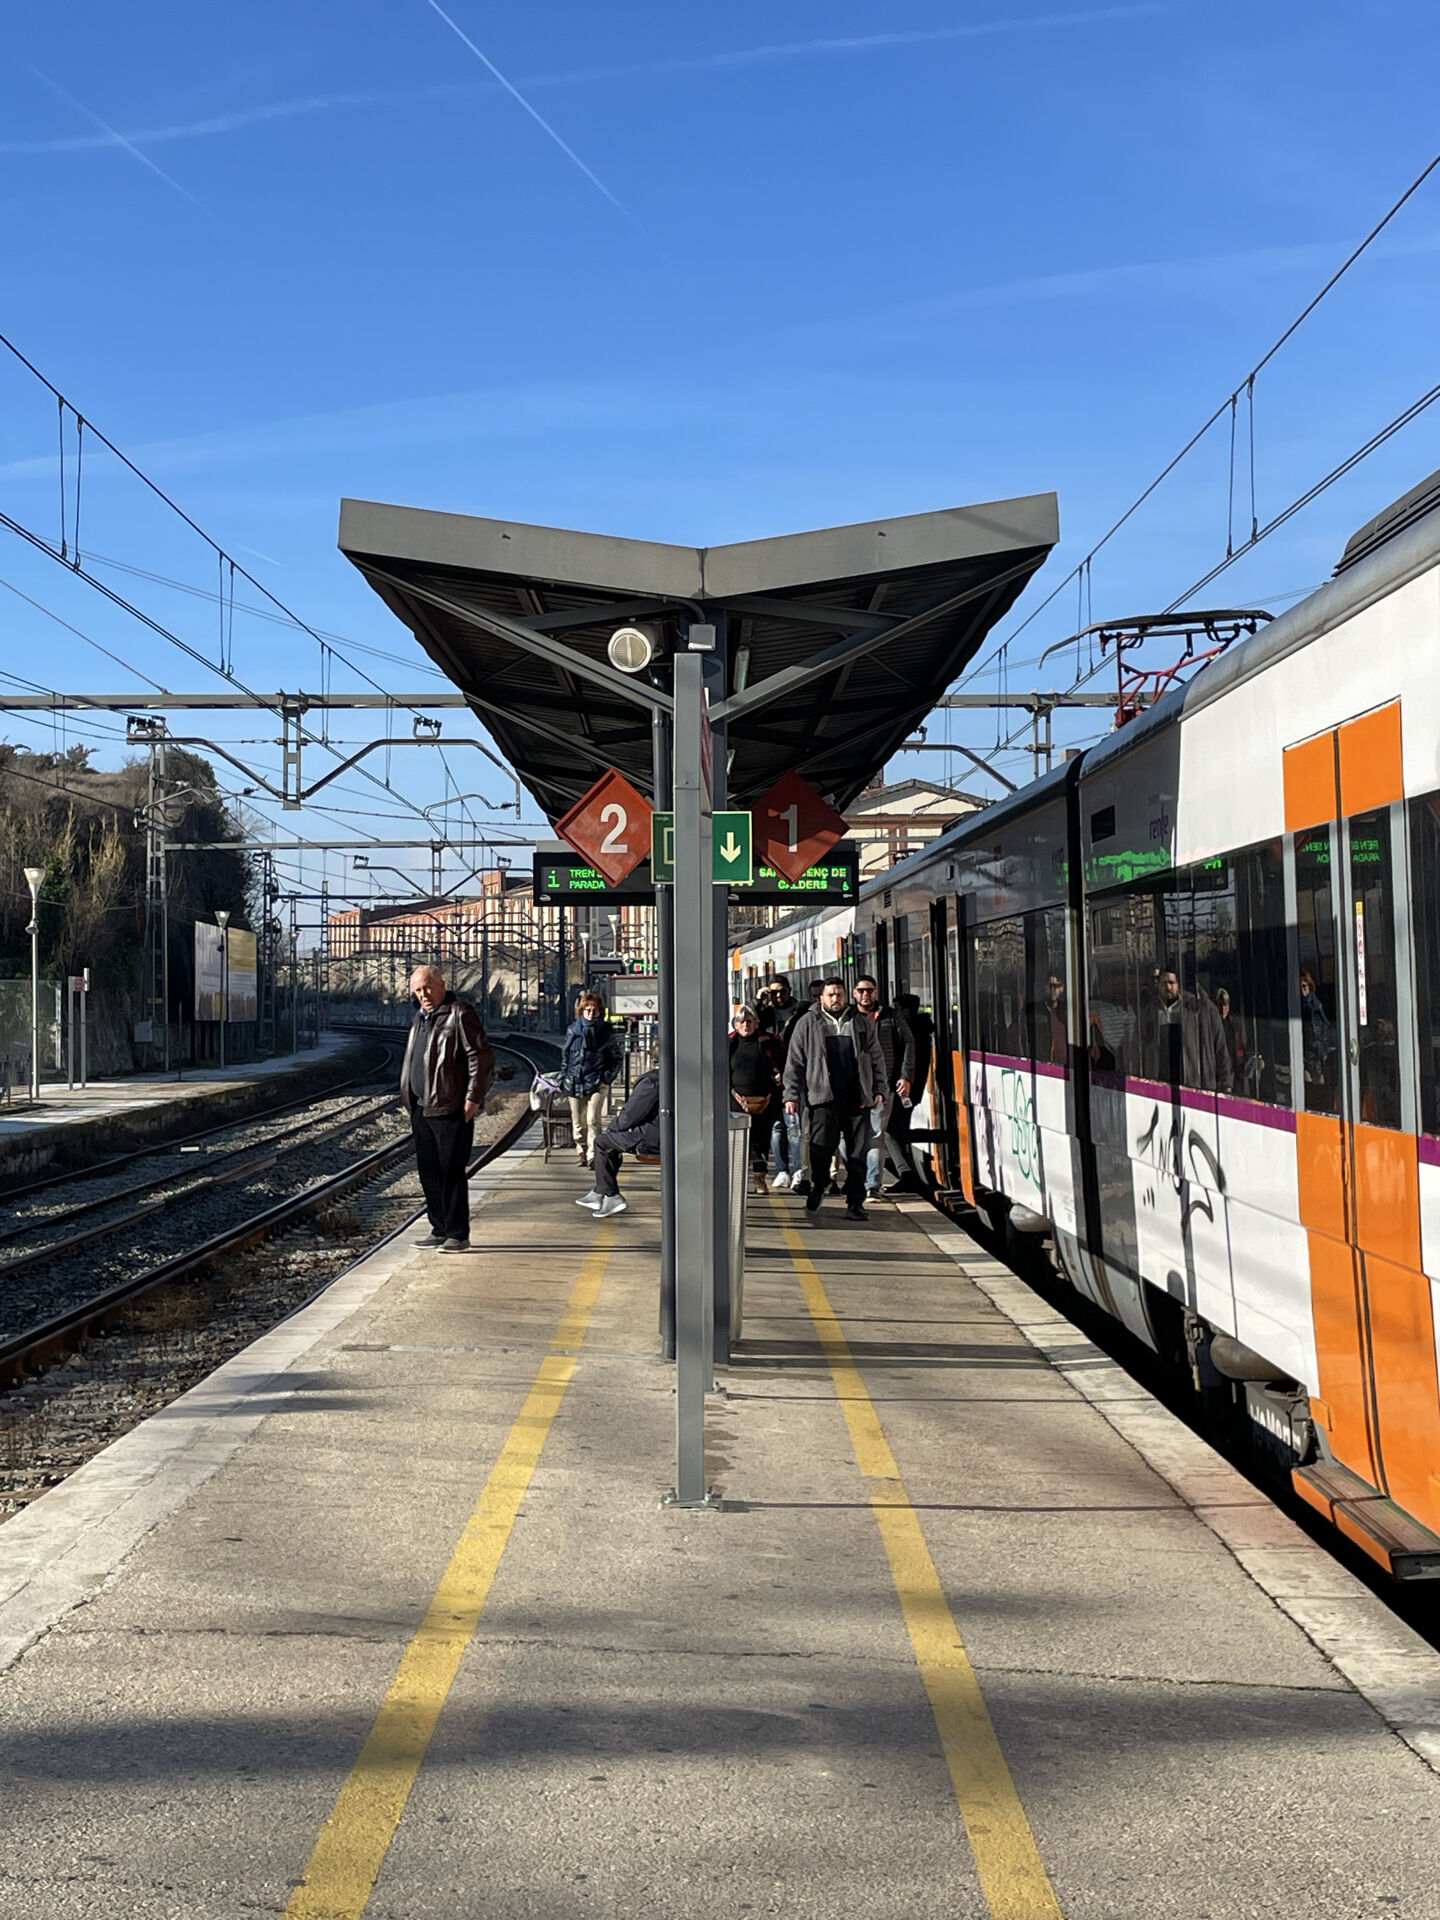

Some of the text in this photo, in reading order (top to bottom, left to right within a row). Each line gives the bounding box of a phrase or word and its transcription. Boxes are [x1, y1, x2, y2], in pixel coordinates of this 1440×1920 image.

[600, 803, 628, 854] 2
[779, 803, 798, 853] 1
[569, 868, 595, 878] TREN
[802, 867, 829, 880] ENÇ
[831, 867, 847, 878] DE
[569, 880, 606, 889] PARADA
